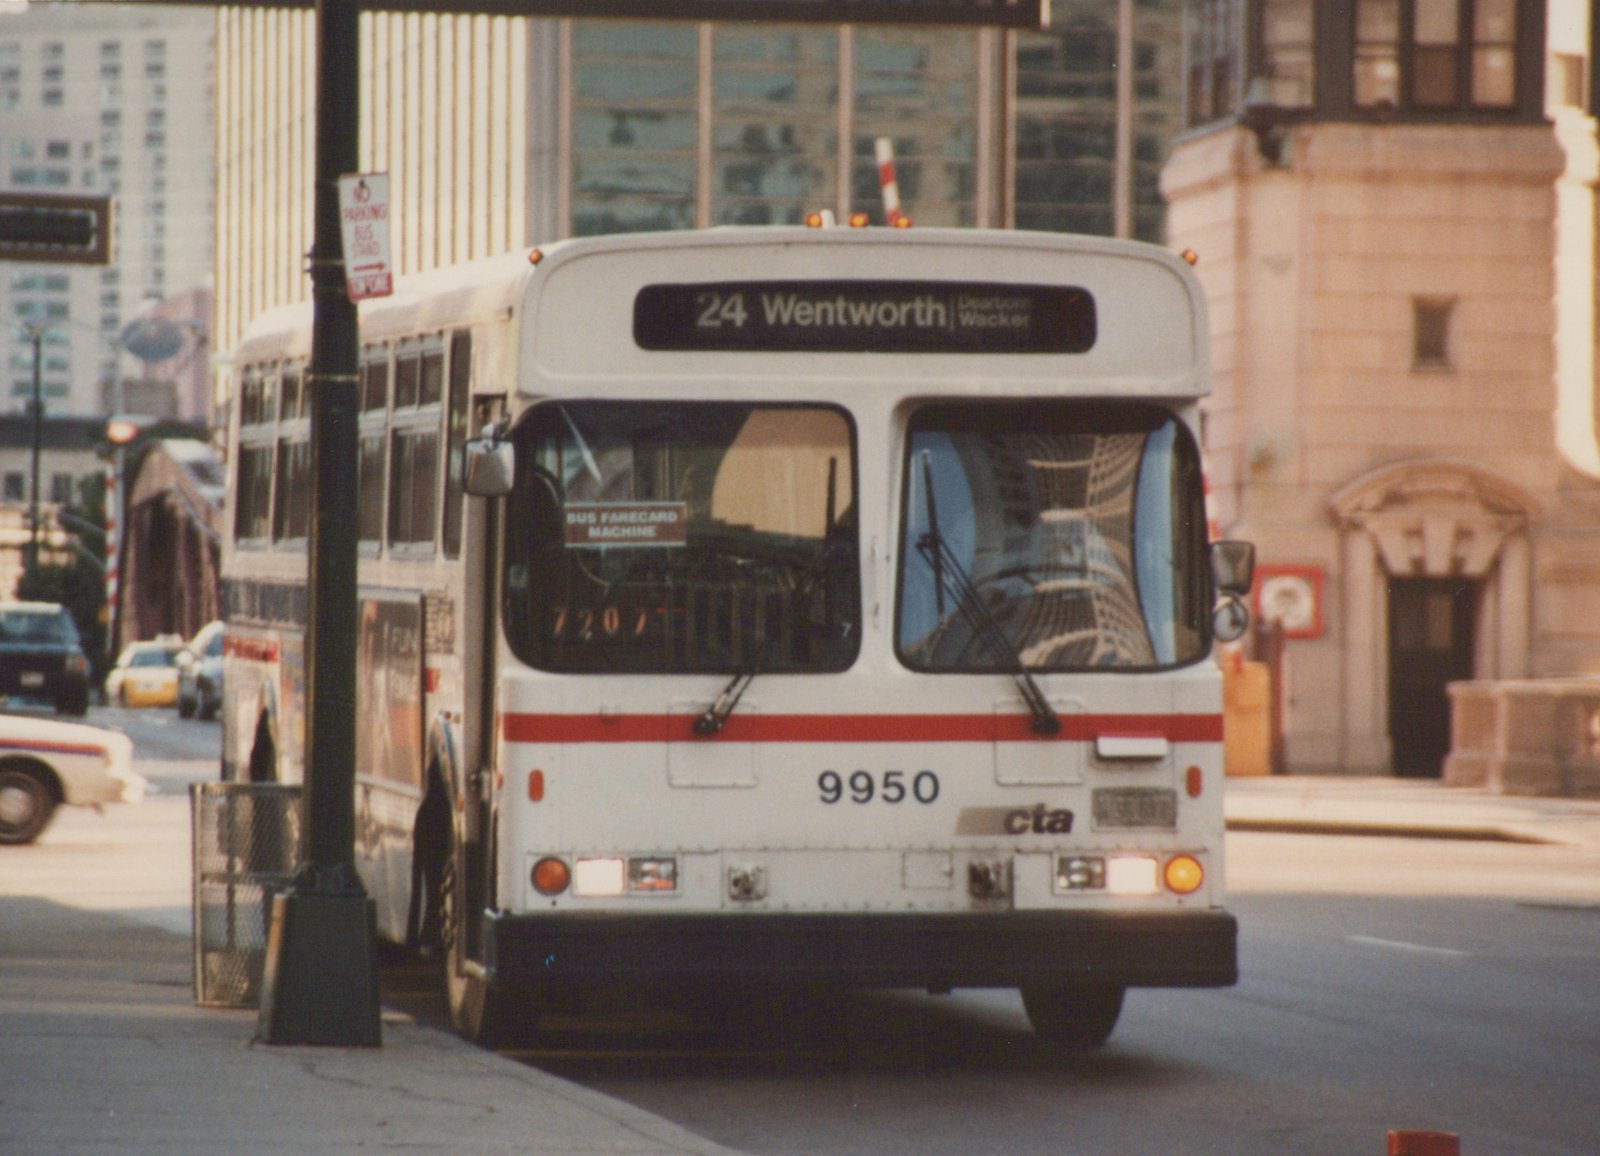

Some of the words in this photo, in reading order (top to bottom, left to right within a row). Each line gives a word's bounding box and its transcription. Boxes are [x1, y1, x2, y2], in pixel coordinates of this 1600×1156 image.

[353, 184, 371, 202] NO
[344, 203, 387, 221] PARKING
[697, 293, 747, 328] 24
[762, 293, 948, 328] Wentworth
[961, 311, 1031, 327] Wacker
[567, 512, 596, 524] BUS
[601, 511, 677, 523] FARECARD
[588, 526, 655, 538] MACHINE
[817, 770, 940, 804] 9950
[1003, 803, 1074, 835] cta
